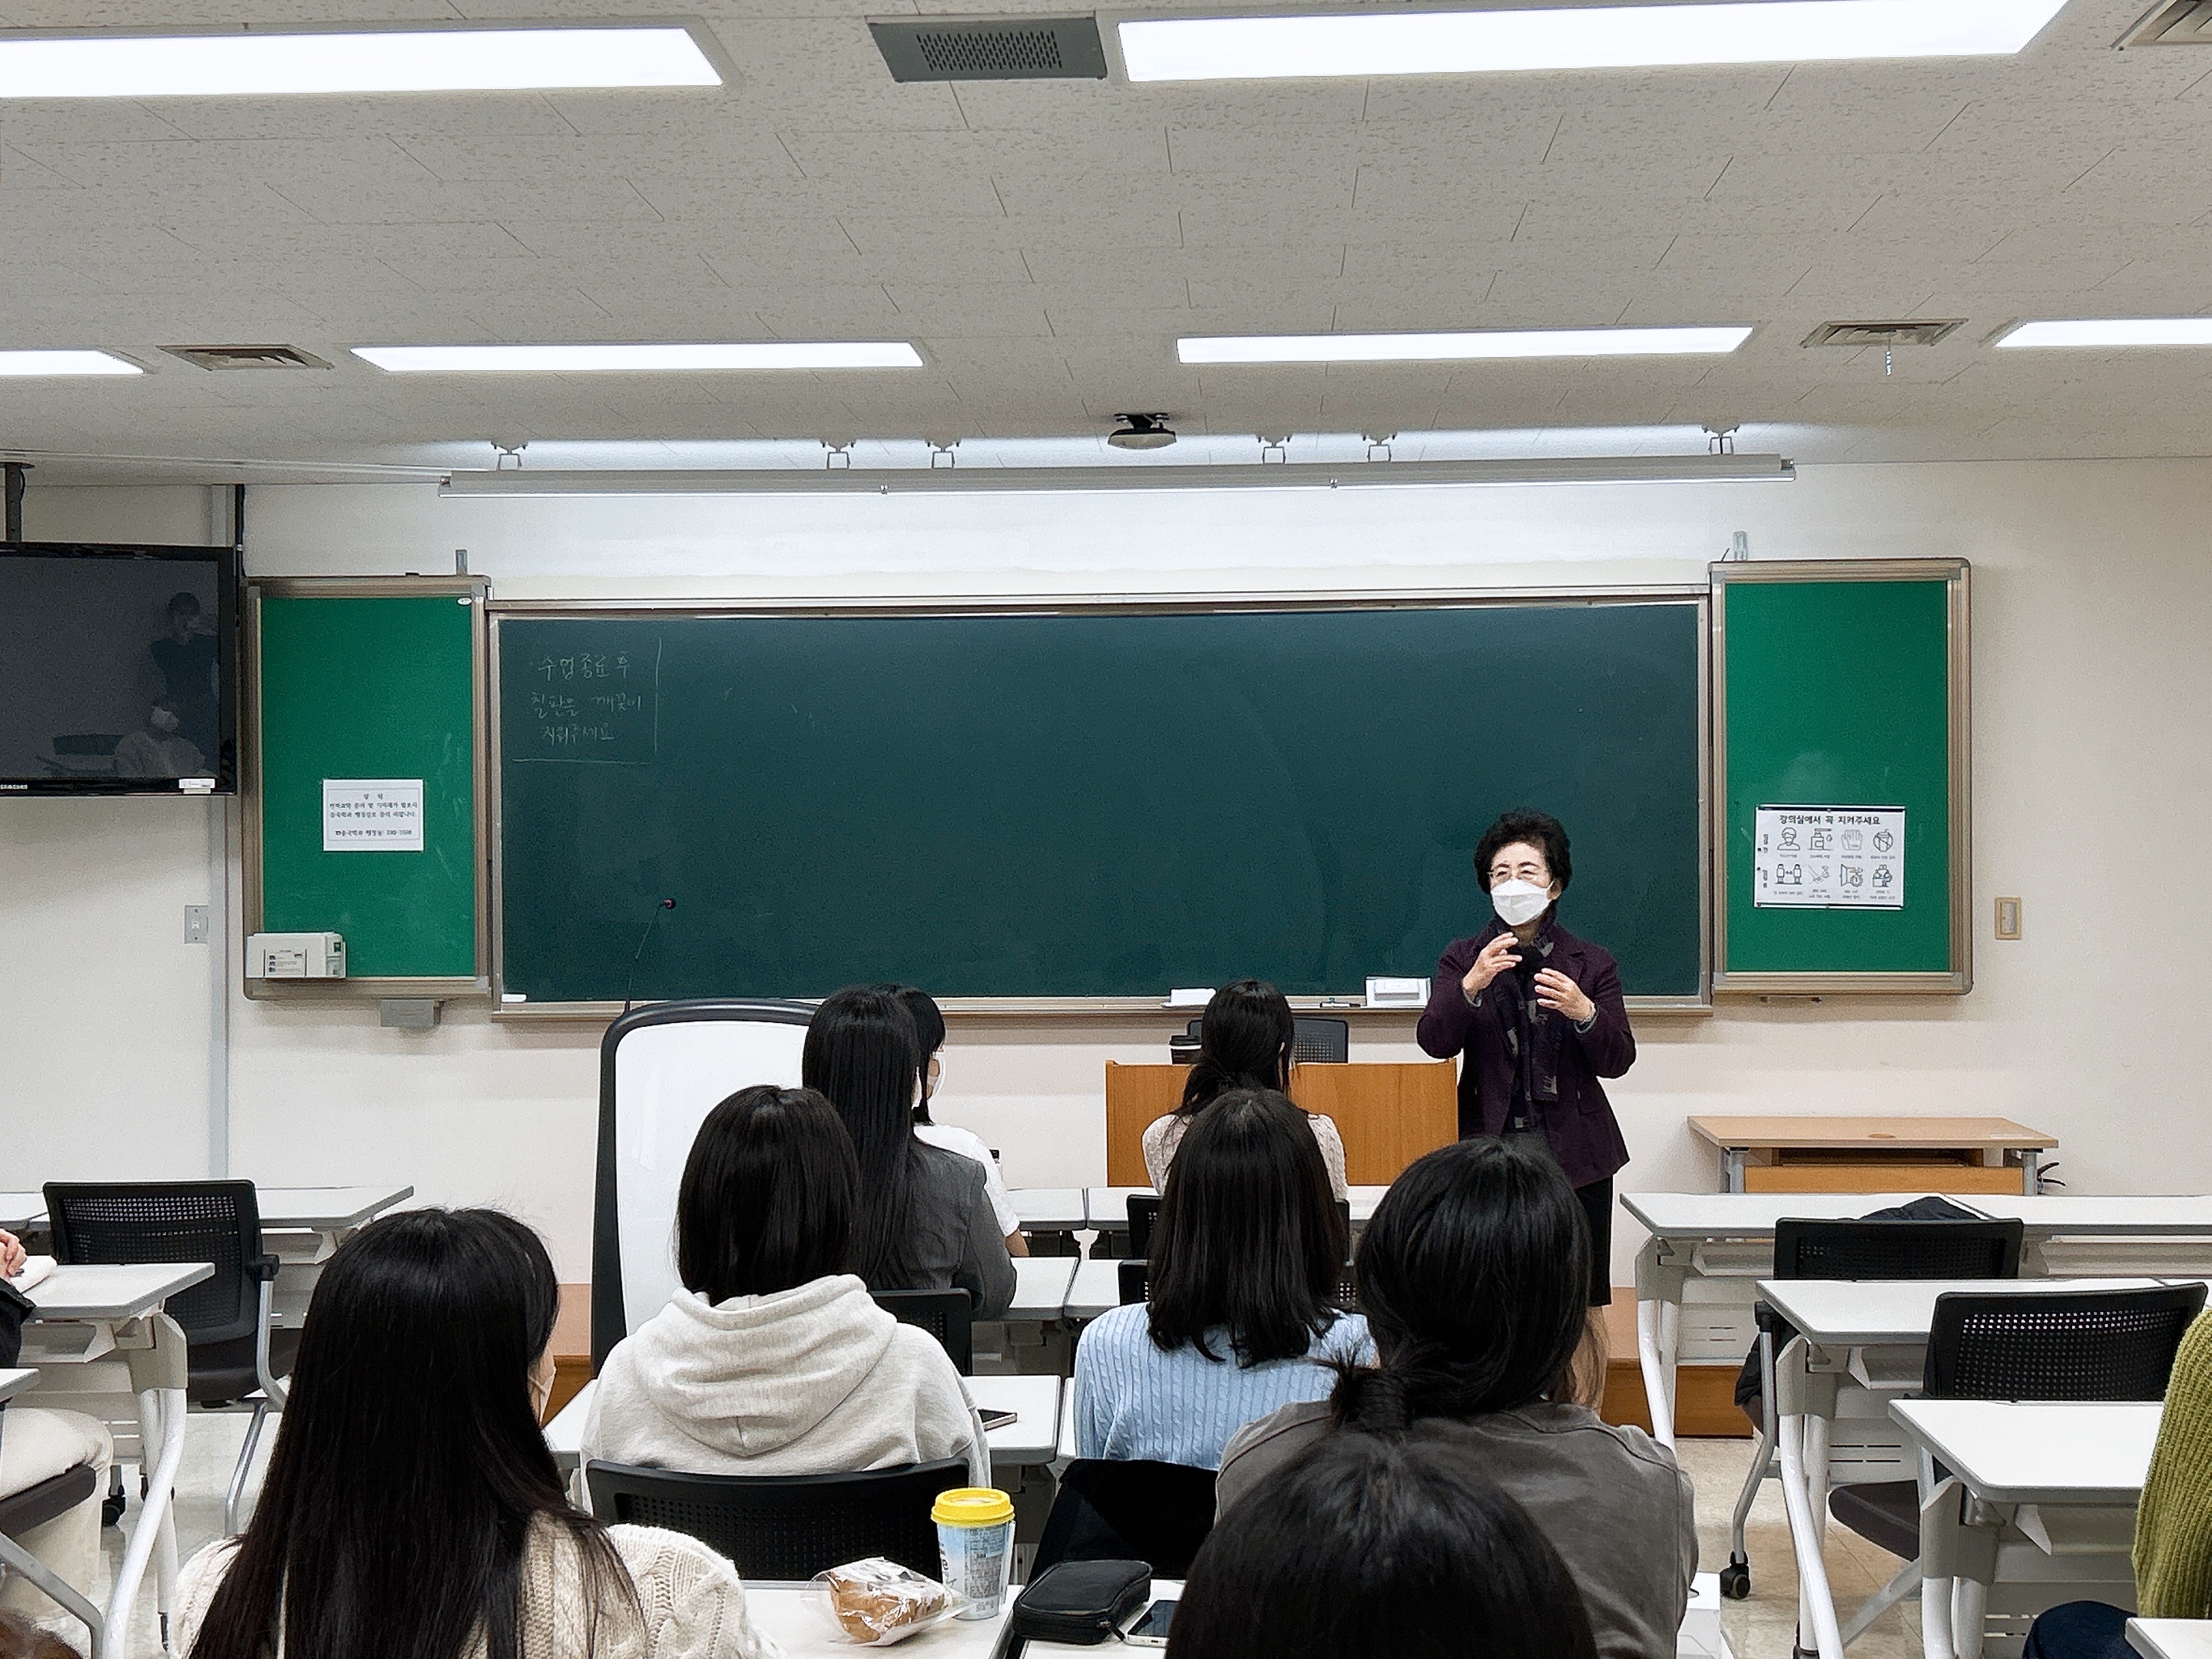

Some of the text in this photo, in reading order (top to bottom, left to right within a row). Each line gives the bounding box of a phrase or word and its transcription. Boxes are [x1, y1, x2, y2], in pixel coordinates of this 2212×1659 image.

[616, 650, 631, 679] 후
[591, 692, 642, 713] 깨끗이
[1779, 815, 1880, 825] 강의실에서 꼭 지켜주세요
